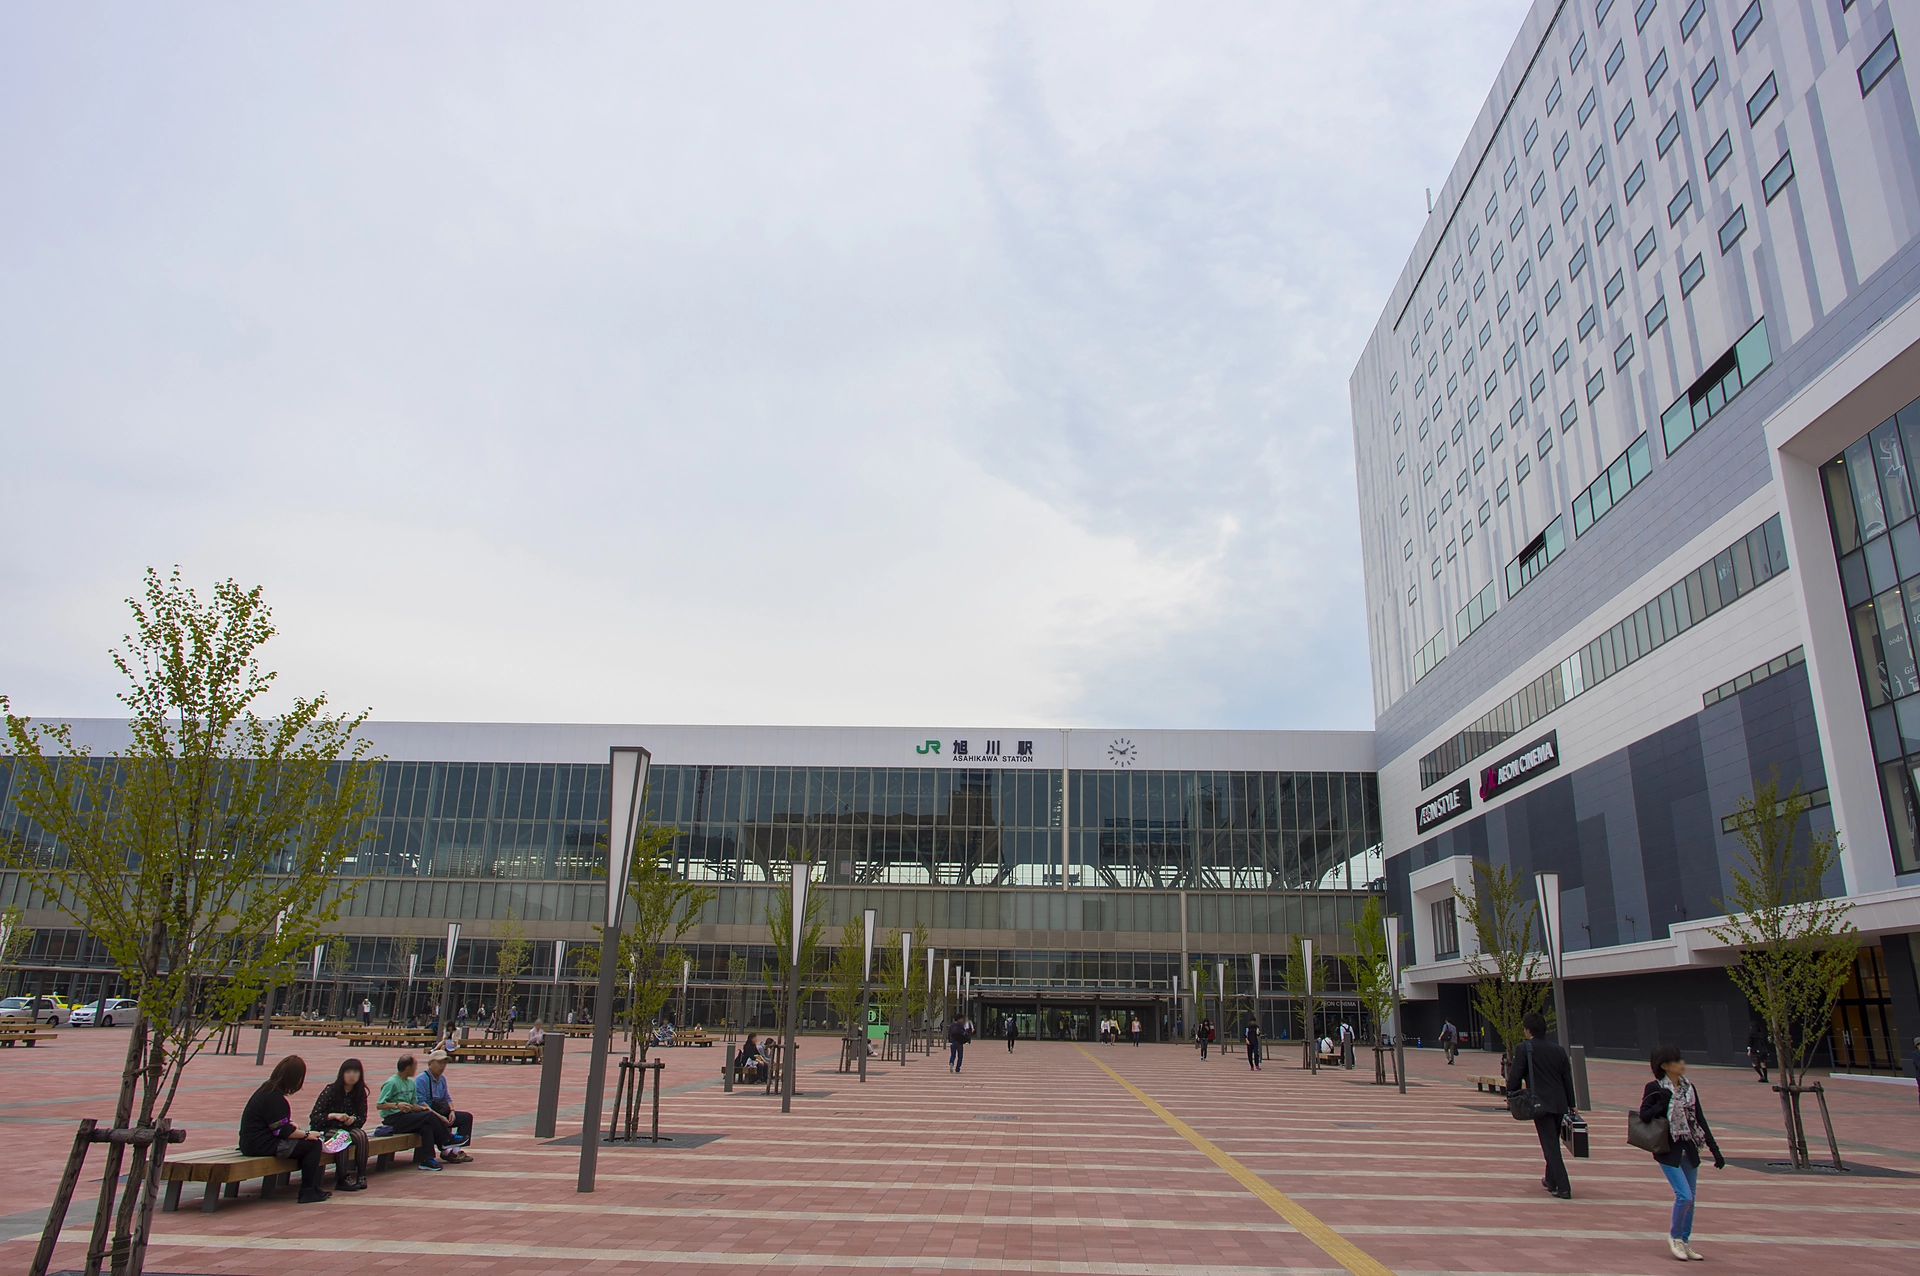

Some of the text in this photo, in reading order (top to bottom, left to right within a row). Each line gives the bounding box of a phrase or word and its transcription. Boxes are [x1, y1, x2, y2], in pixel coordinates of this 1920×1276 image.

[916, 740, 1034, 755] JR 旭川駅
[1519, 742, 1554, 773] CINEMA
